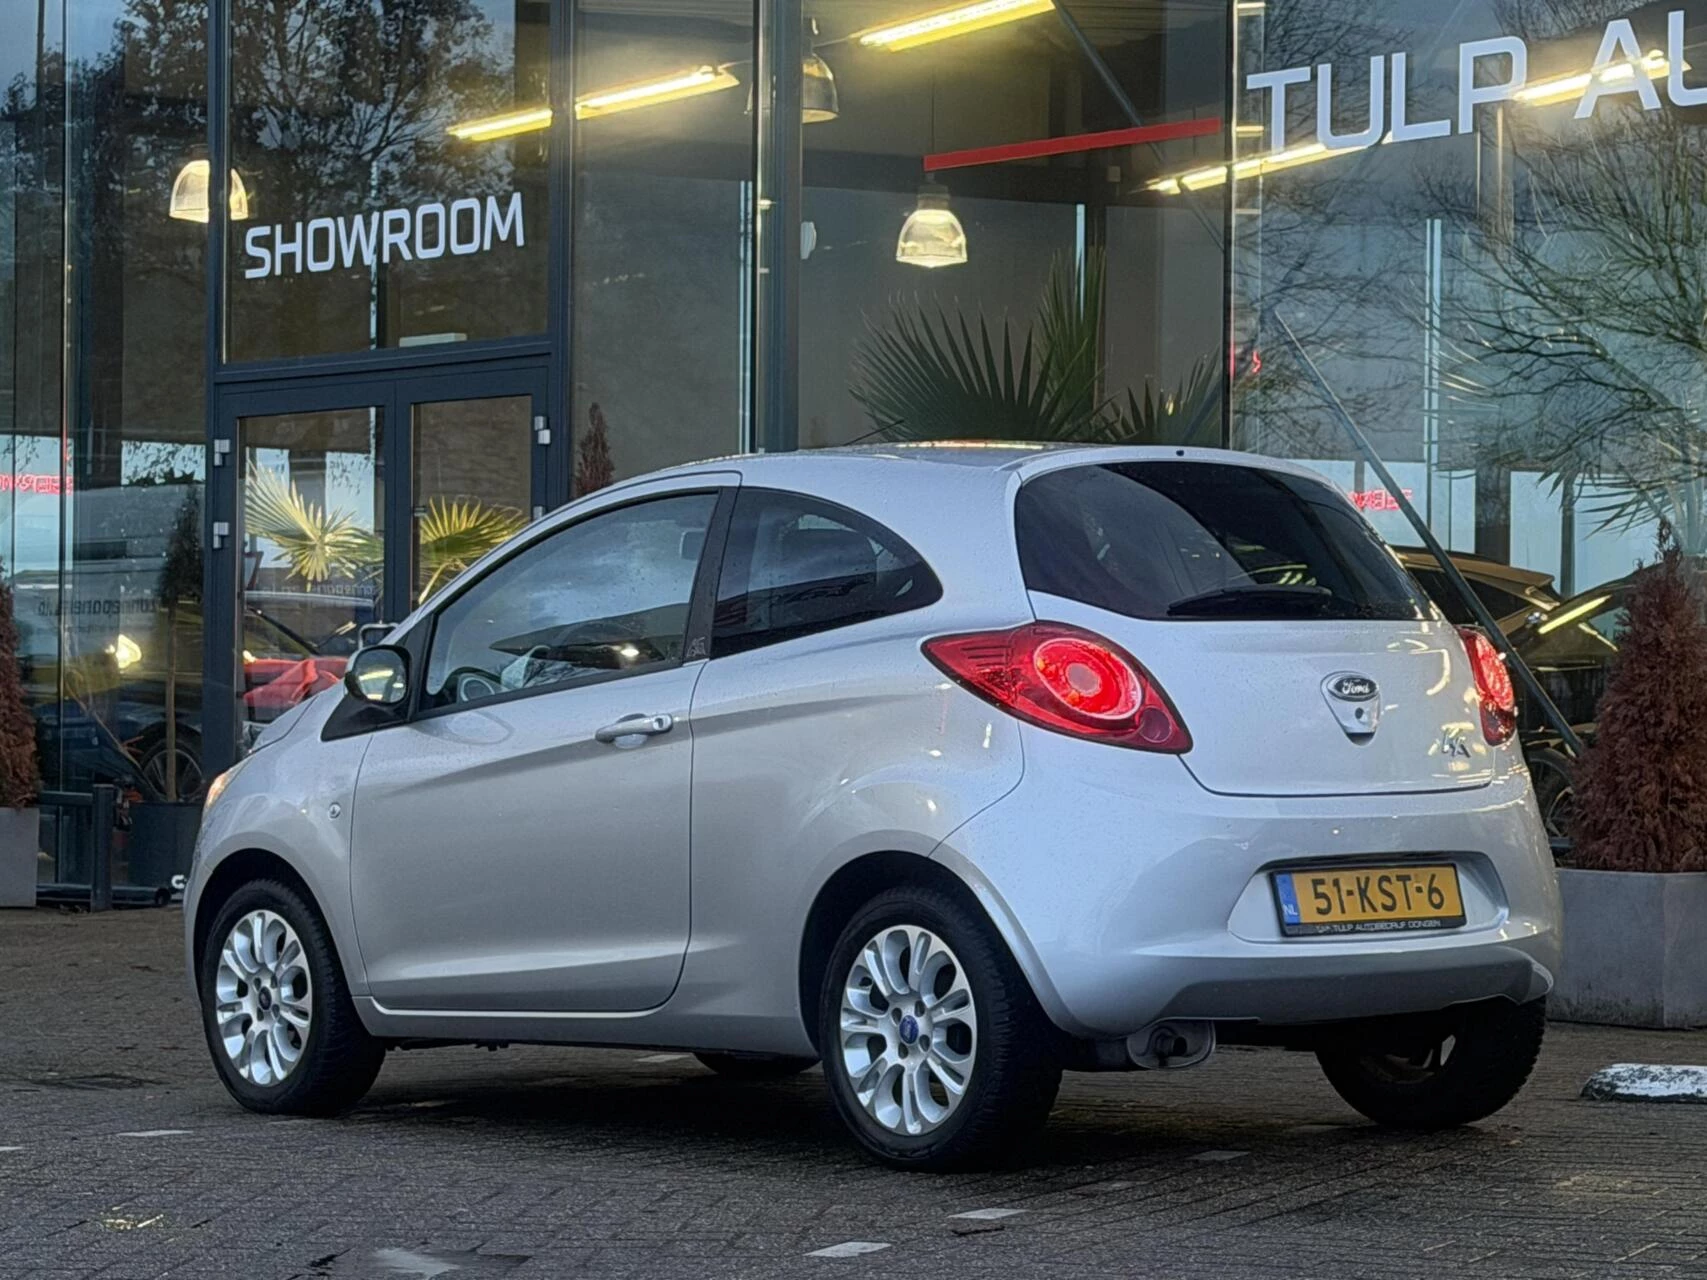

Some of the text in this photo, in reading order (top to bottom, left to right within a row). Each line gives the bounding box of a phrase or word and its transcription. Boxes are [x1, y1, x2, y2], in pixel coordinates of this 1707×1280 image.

[1246, 36, 1527, 151] TULP
[245, 192, 525, 279] SHOWROOM
[1342, 679, 1370, 695] Ford
[1282, 903, 1298, 916] NL
[1311, 873, 1445, 916] 51-KST-6
